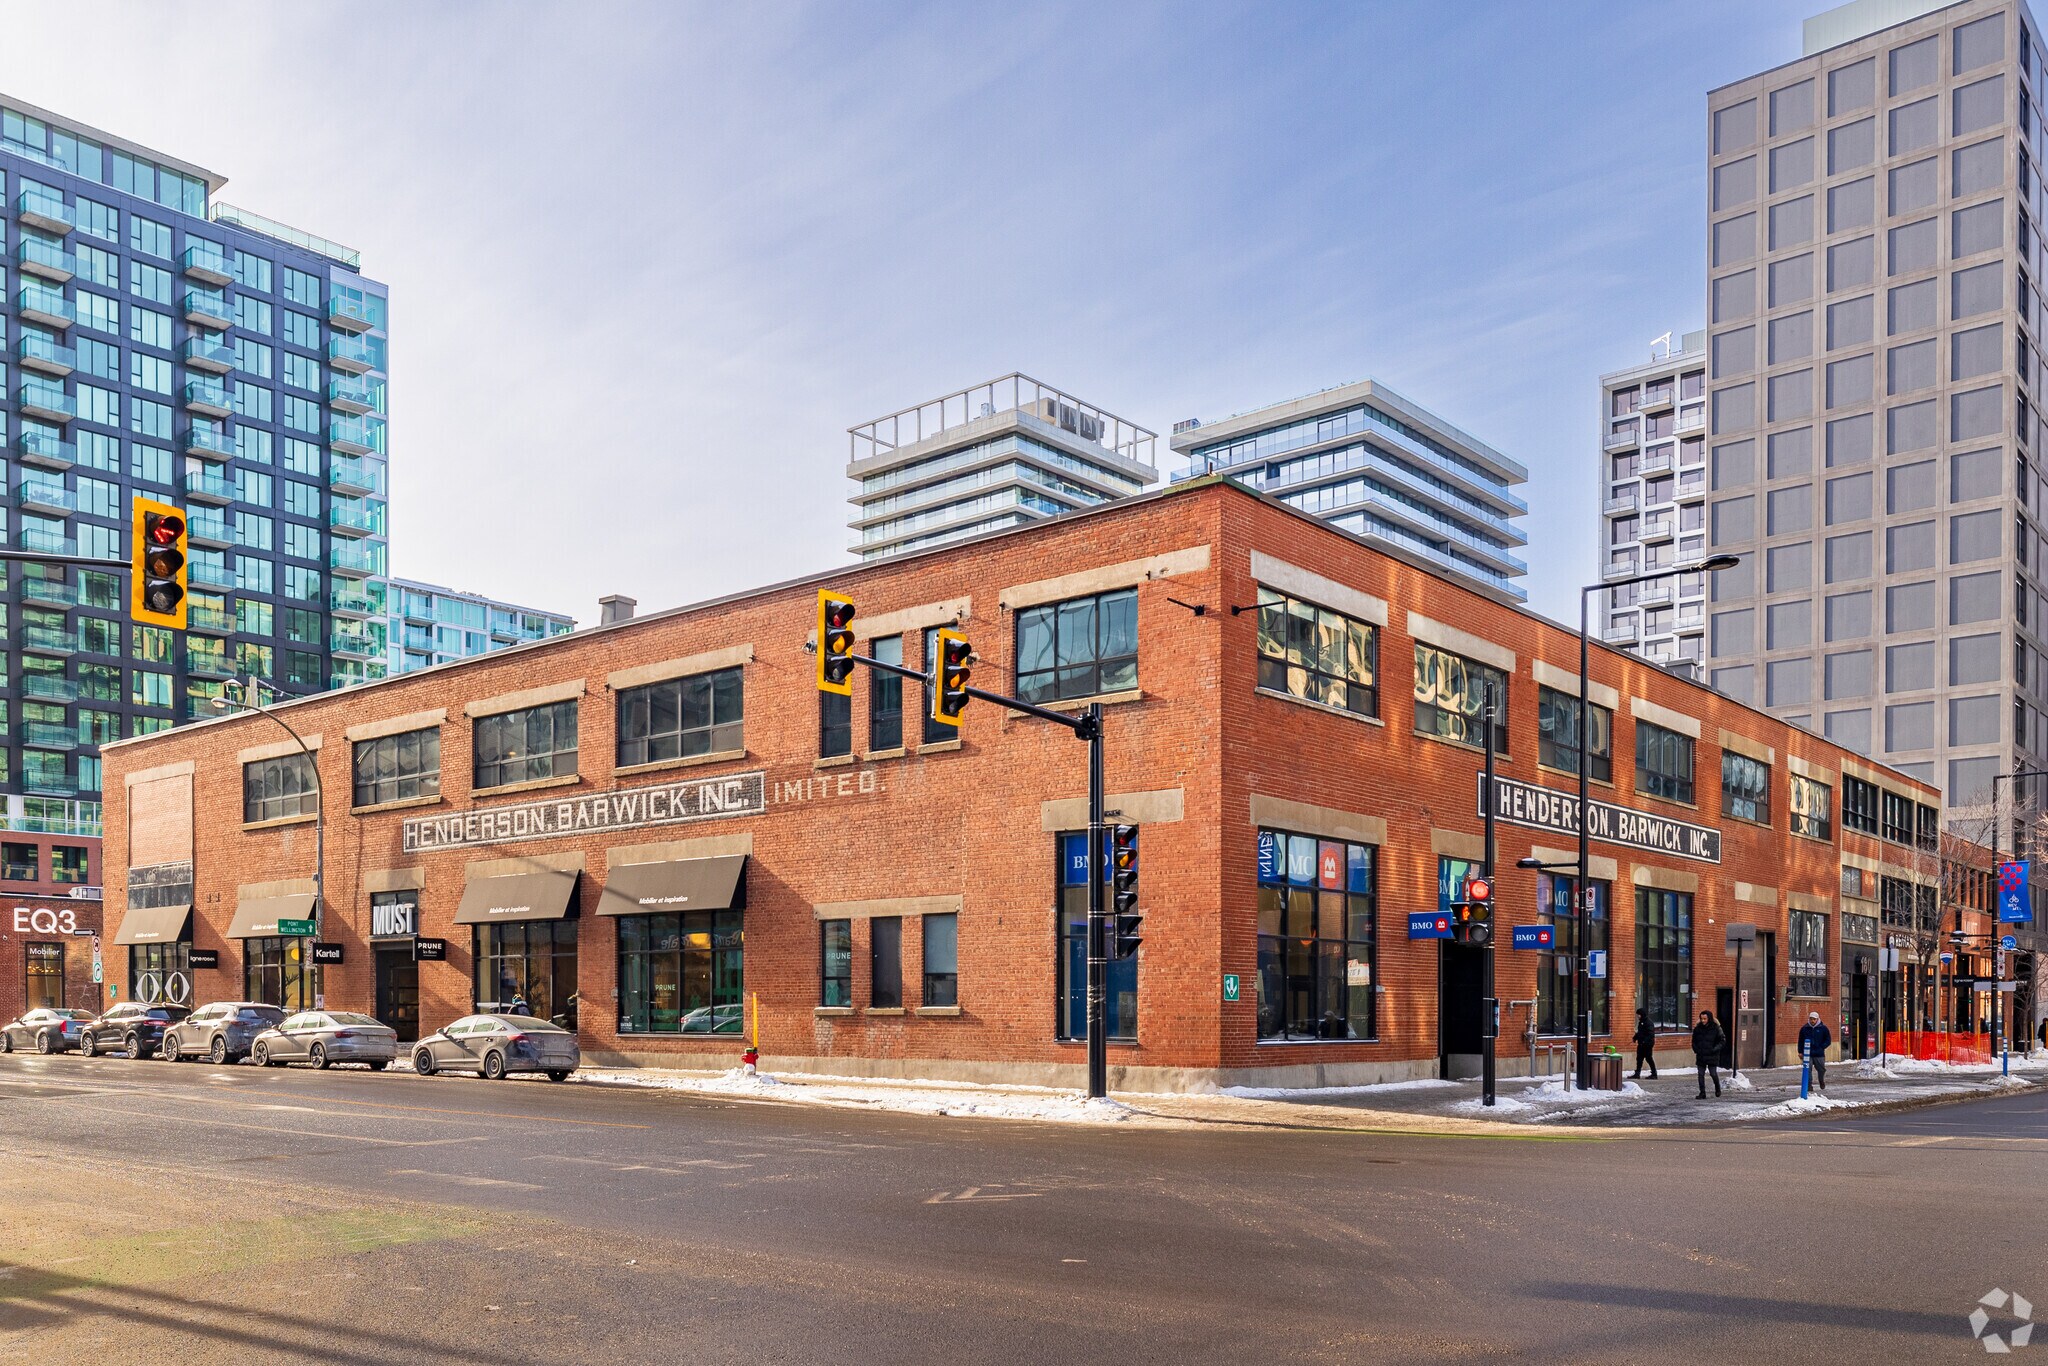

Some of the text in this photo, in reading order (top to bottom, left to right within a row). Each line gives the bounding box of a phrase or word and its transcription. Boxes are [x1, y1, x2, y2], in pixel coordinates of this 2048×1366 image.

[557, 788, 687, 830] BARWICK
[699, 780, 750, 813] INC.
[1618, 812, 1682, 851] BARWICK
[1689, 829, 1711, 857] INC.
[13, 907, 77, 934] EQ3
[373, 903, 415, 935] MUST
[1411, 921, 1433, 930] BMO
[1516, 933, 1537, 941] BMO
[417, 942, 442, 950] PRUNE
[29, 947, 60, 956] Mobilier
[315, 949, 340, 958] Kartell
[827, 952, 851, 960] PRUNE
